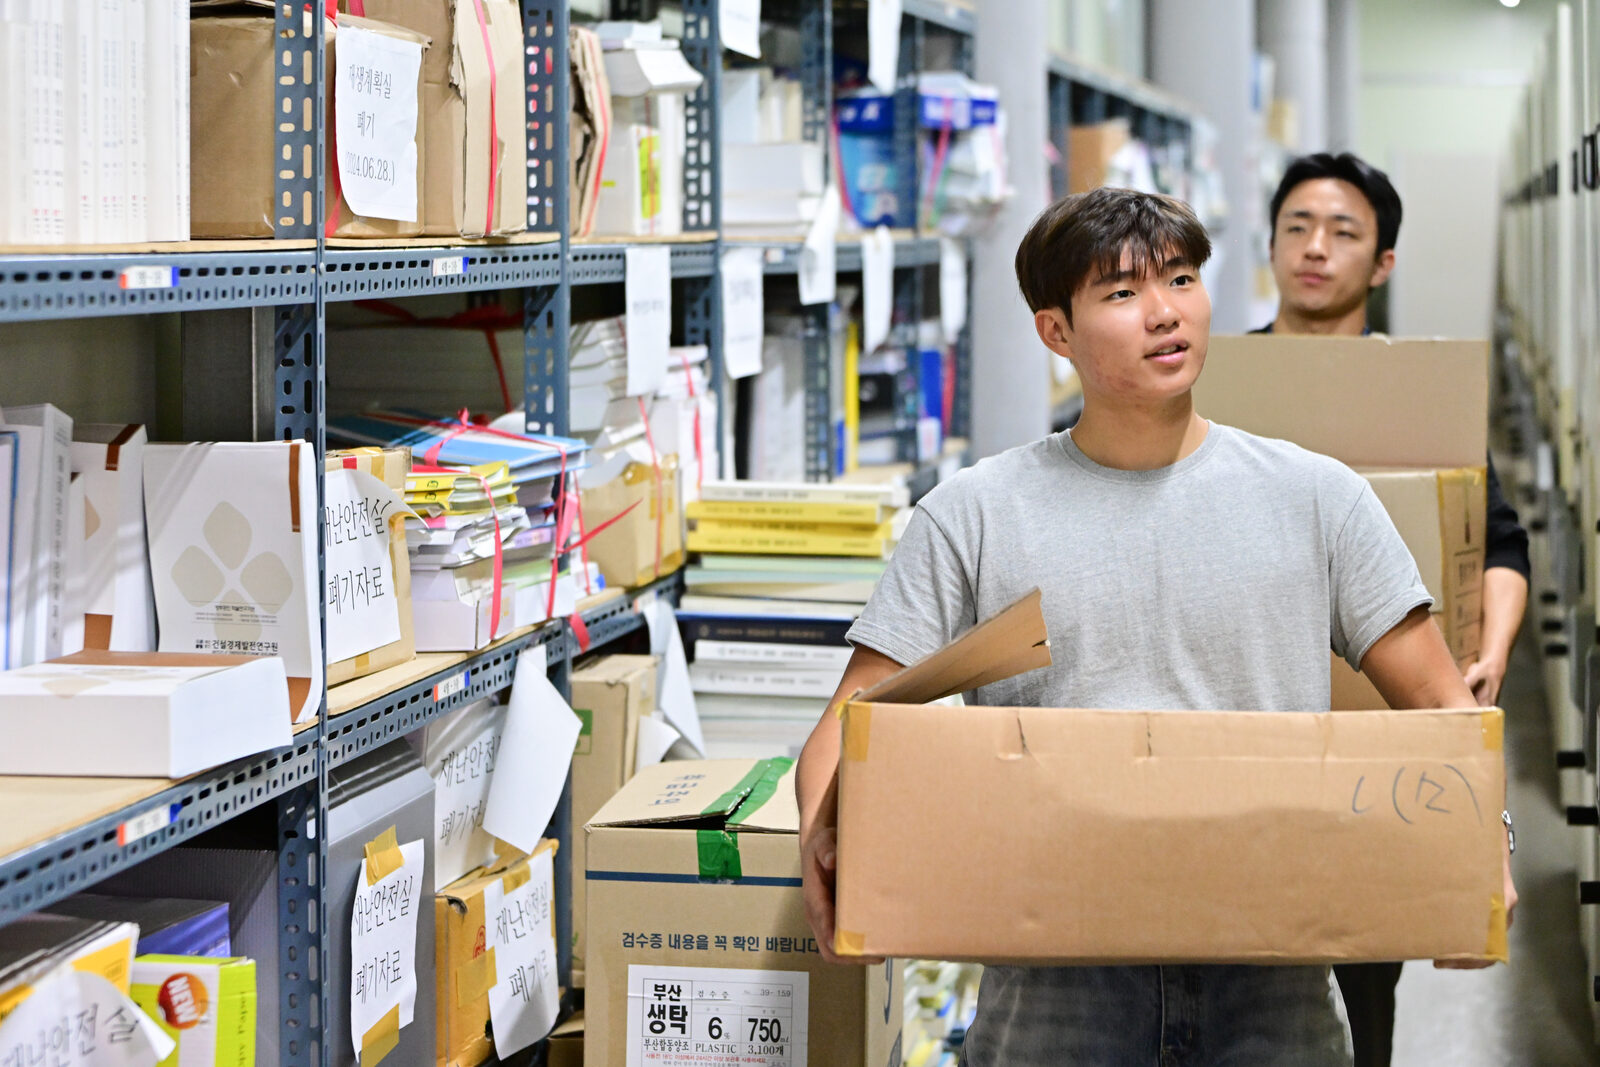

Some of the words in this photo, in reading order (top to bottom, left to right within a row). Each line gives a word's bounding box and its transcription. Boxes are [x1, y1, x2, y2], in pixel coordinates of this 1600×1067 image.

[357, 111, 375, 139] 폐기
[328, 566, 385, 615] 폐기자료
[213, 640, 278, 652] 건설경제발전연구원
[622, 932, 662, 949] 검수증
[668, 934, 709, 950] 내용을
[714, 936, 727, 951] 꼭
[733, 936, 759, 952] 확인
[356, 950, 401, 1005] 폐기자료
[167, 976, 198, 1024] NEW
[653, 983, 682, 1002] 부산
[647, 1003, 688, 1035] 생탁
[695, 1042, 737, 1054] PLASTIC
